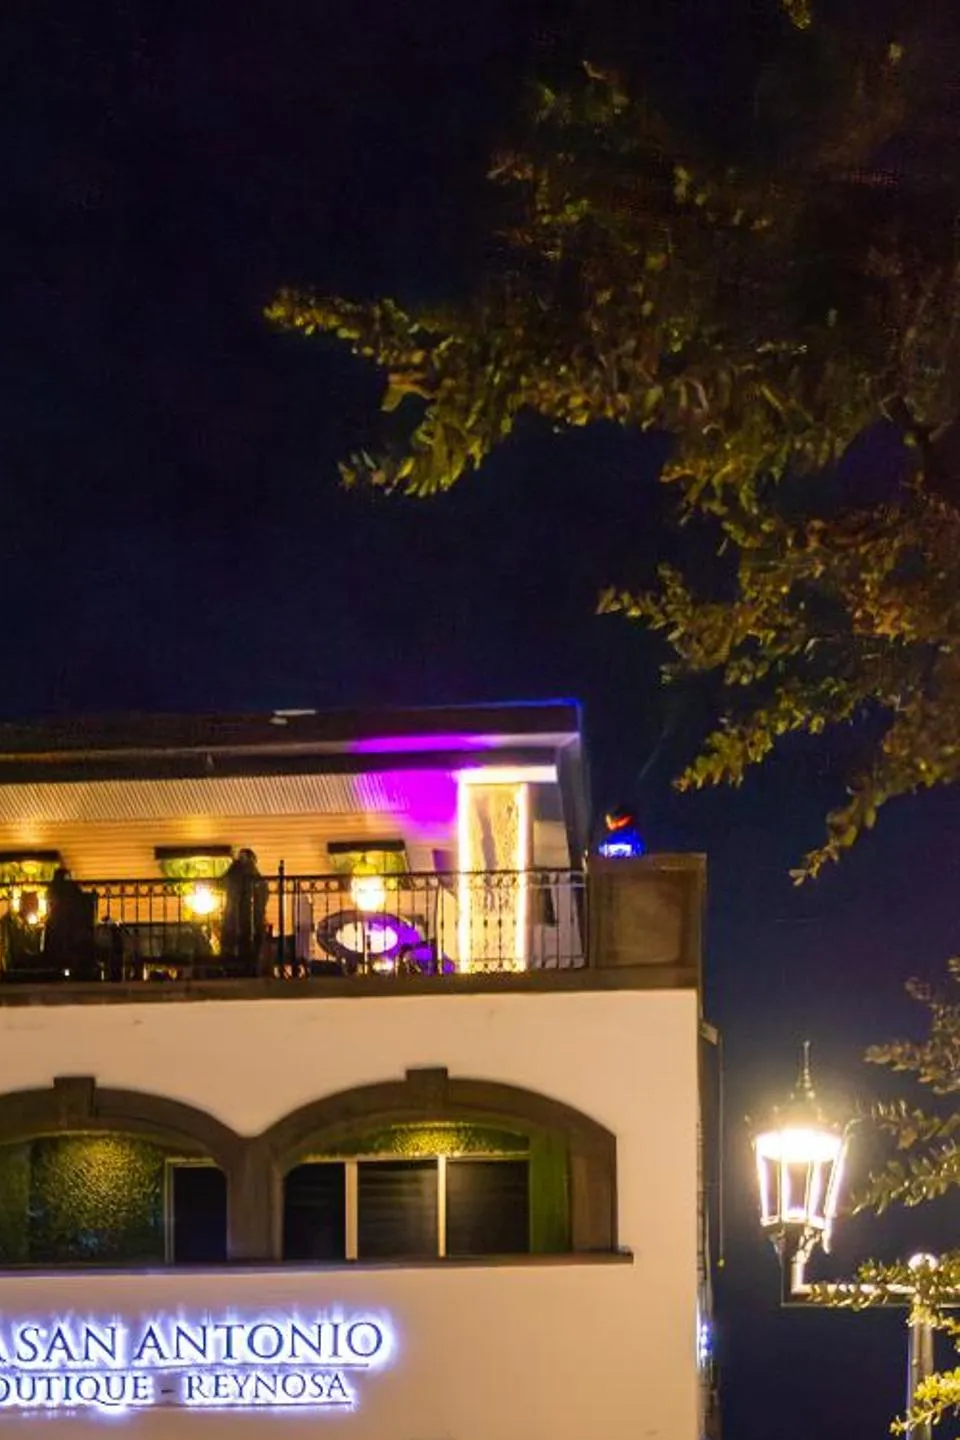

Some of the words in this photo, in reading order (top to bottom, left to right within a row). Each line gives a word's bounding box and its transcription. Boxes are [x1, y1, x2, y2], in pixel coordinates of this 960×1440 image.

[15, 1325, 117, 1363] SAN
[133, 1321, 383, 1360] ANTONIO
[185, 1372, 350, 1400] REYNOSA
